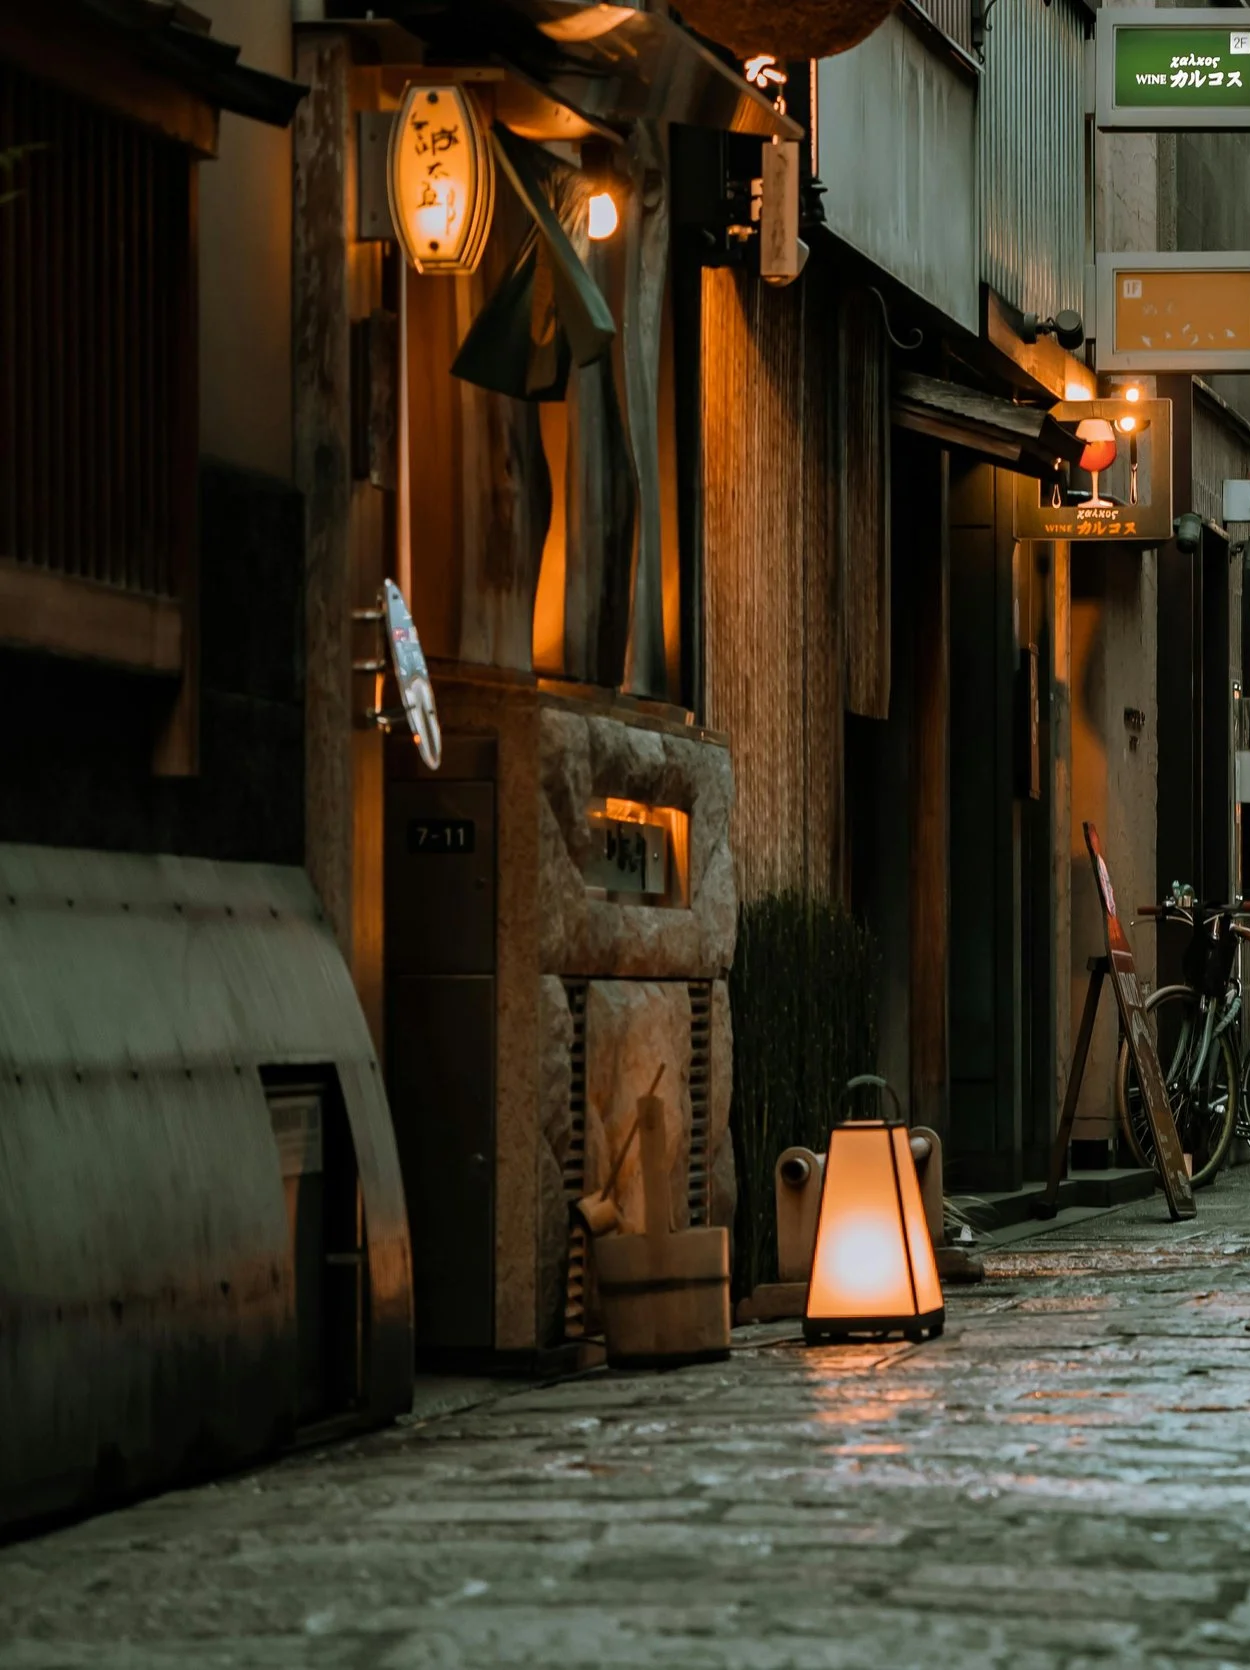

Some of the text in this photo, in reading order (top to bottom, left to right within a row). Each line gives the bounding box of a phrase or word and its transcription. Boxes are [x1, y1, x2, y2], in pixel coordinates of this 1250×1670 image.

[1233, 36, 1248, 49] 2F
[1135, 69, 1243, 88] WINE カルコス
[1044, 520, 1137, 535] WINE カルコス
